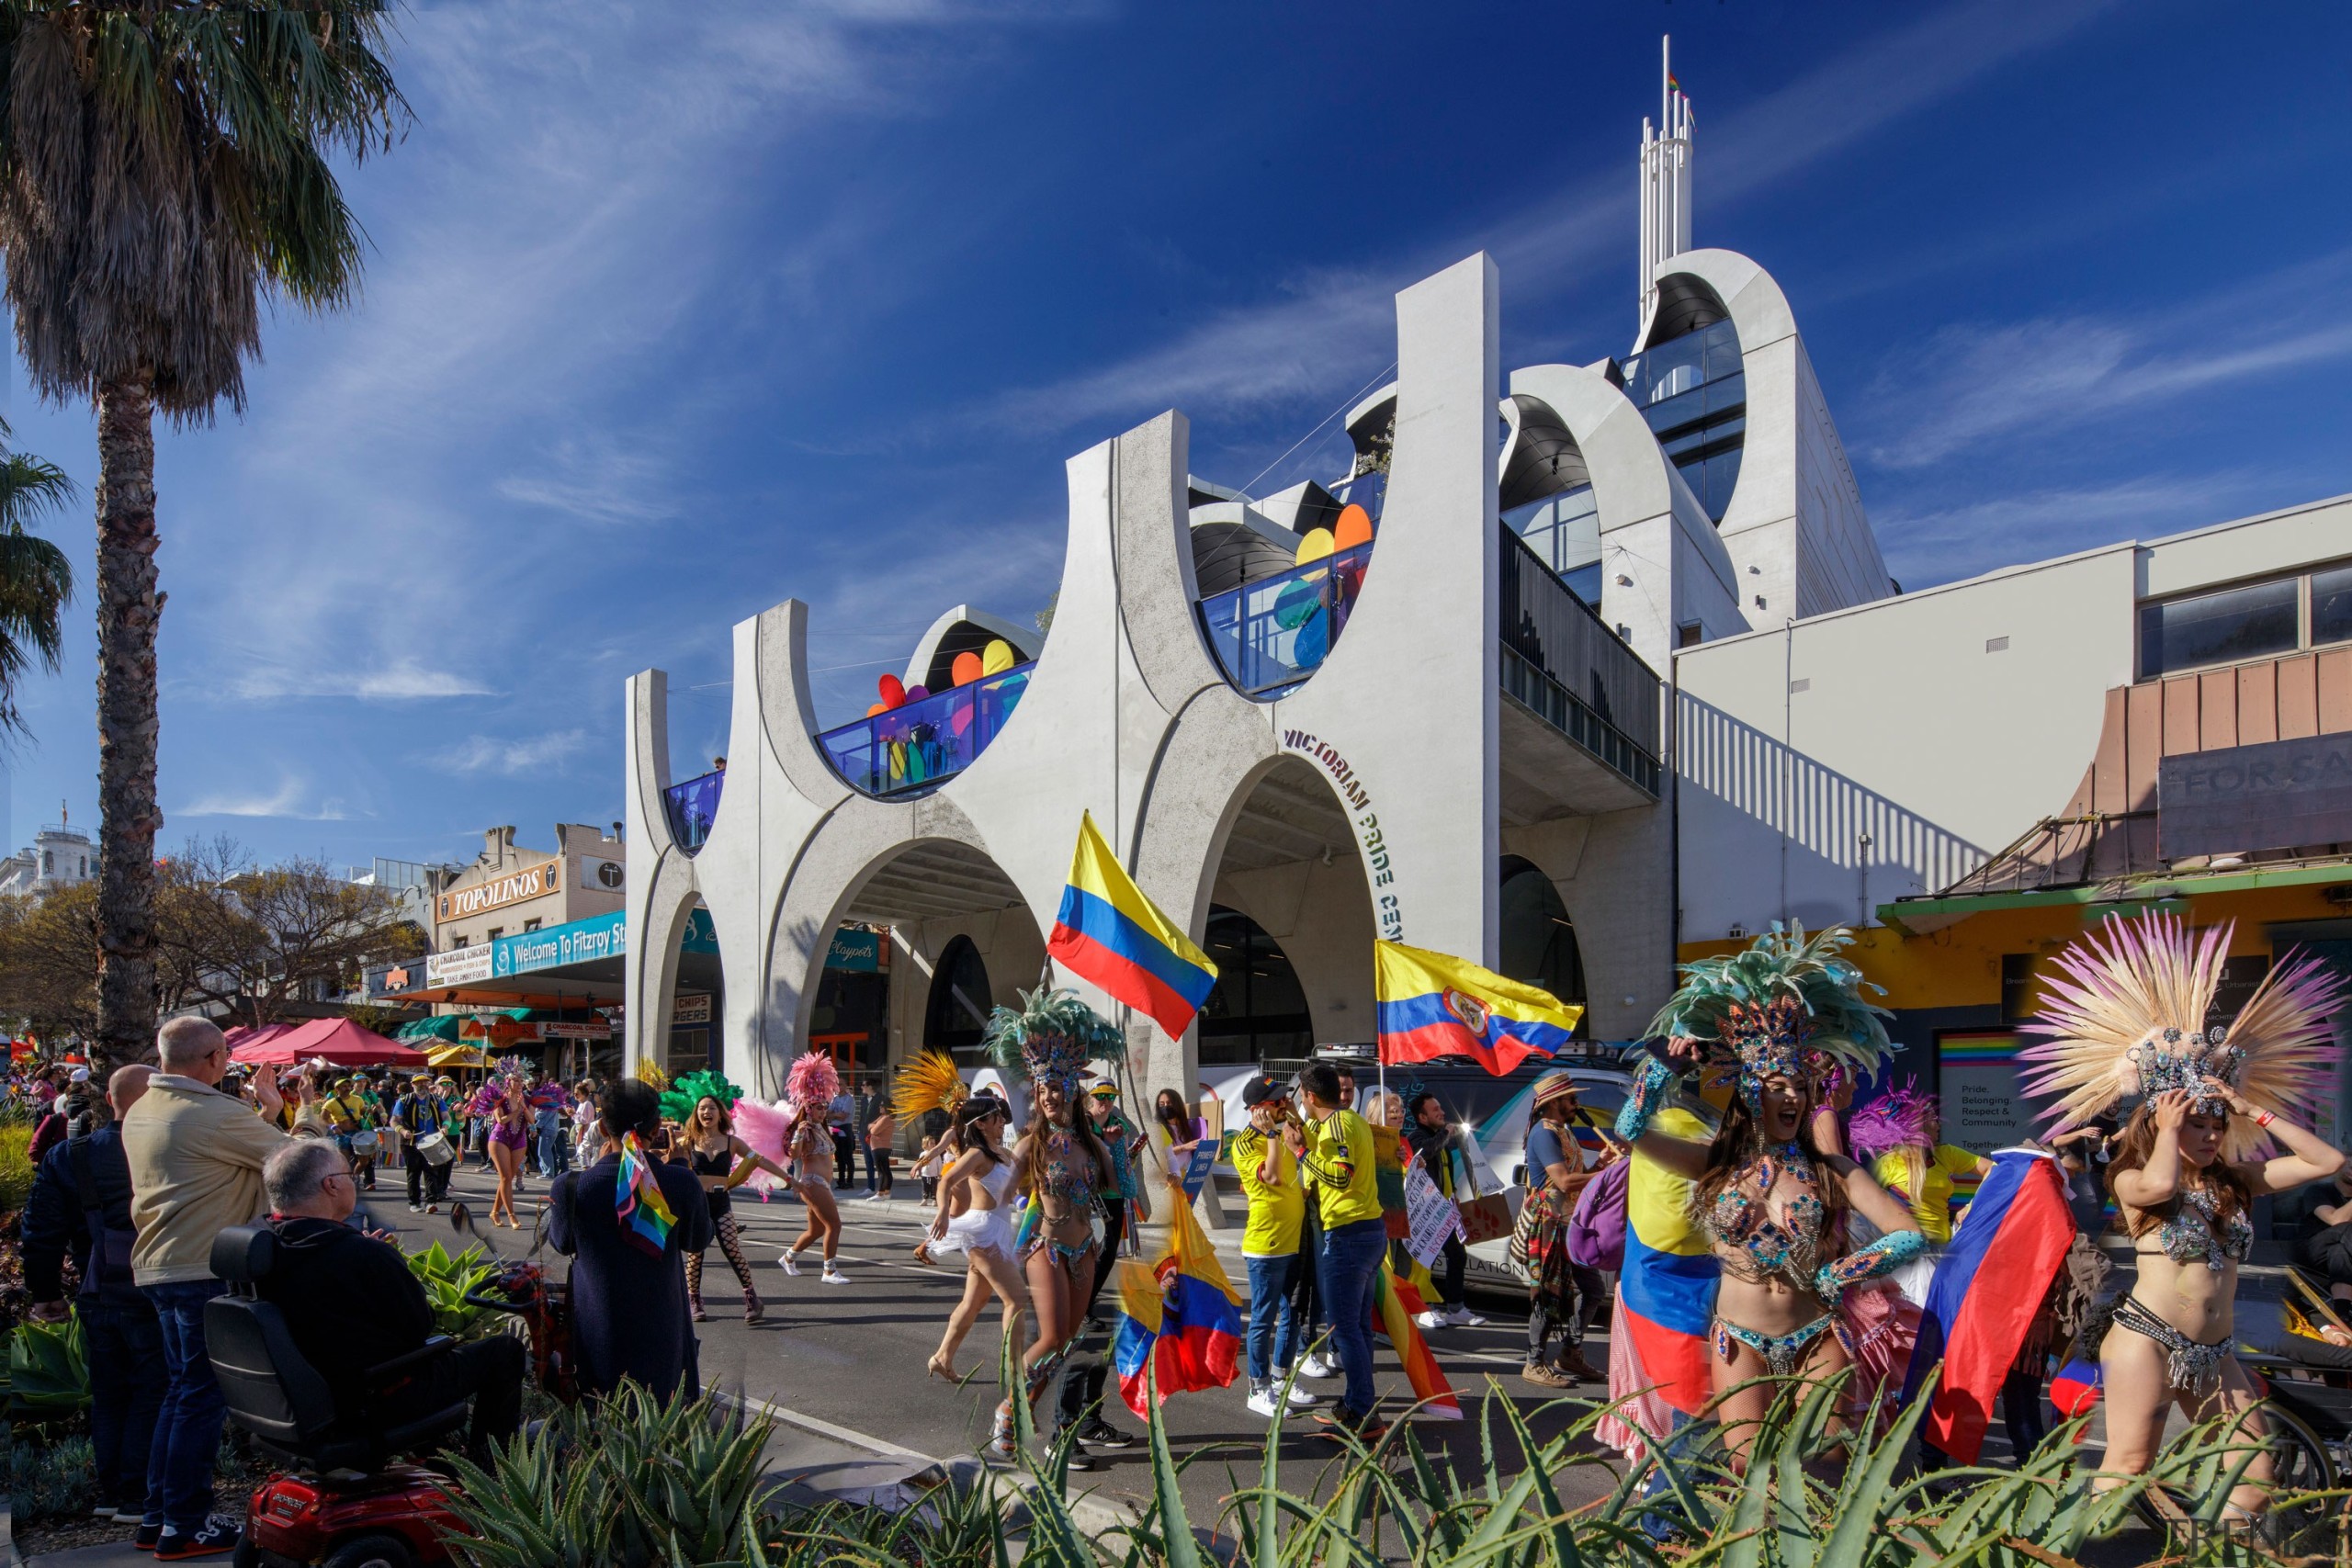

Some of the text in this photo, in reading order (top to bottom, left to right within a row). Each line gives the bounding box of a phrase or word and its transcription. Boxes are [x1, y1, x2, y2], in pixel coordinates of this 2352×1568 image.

[2186, 761, 2276, 796] FOR
[1284, 728, 1404, 944] VICTORIAN PRIDE CEN
[454, 869, 540, 916] TOPOLINOS
[514, 923, 626, 964] Welcome To Fitzroy St
[447, 976, 458, 984] TAKE
[459, 973, 472, 982] AWAY
[473, 970, 487, 978] FOOD
[678, 996, 707, 1009] CHIPS
[552, 1023, 584, 1032] CHARCOAL
[1962, 1107, 2009, 1116] Respect &
[1962, 1118, 2017, 1128] Community
[1962, 1140, 2004, 1150] Together
